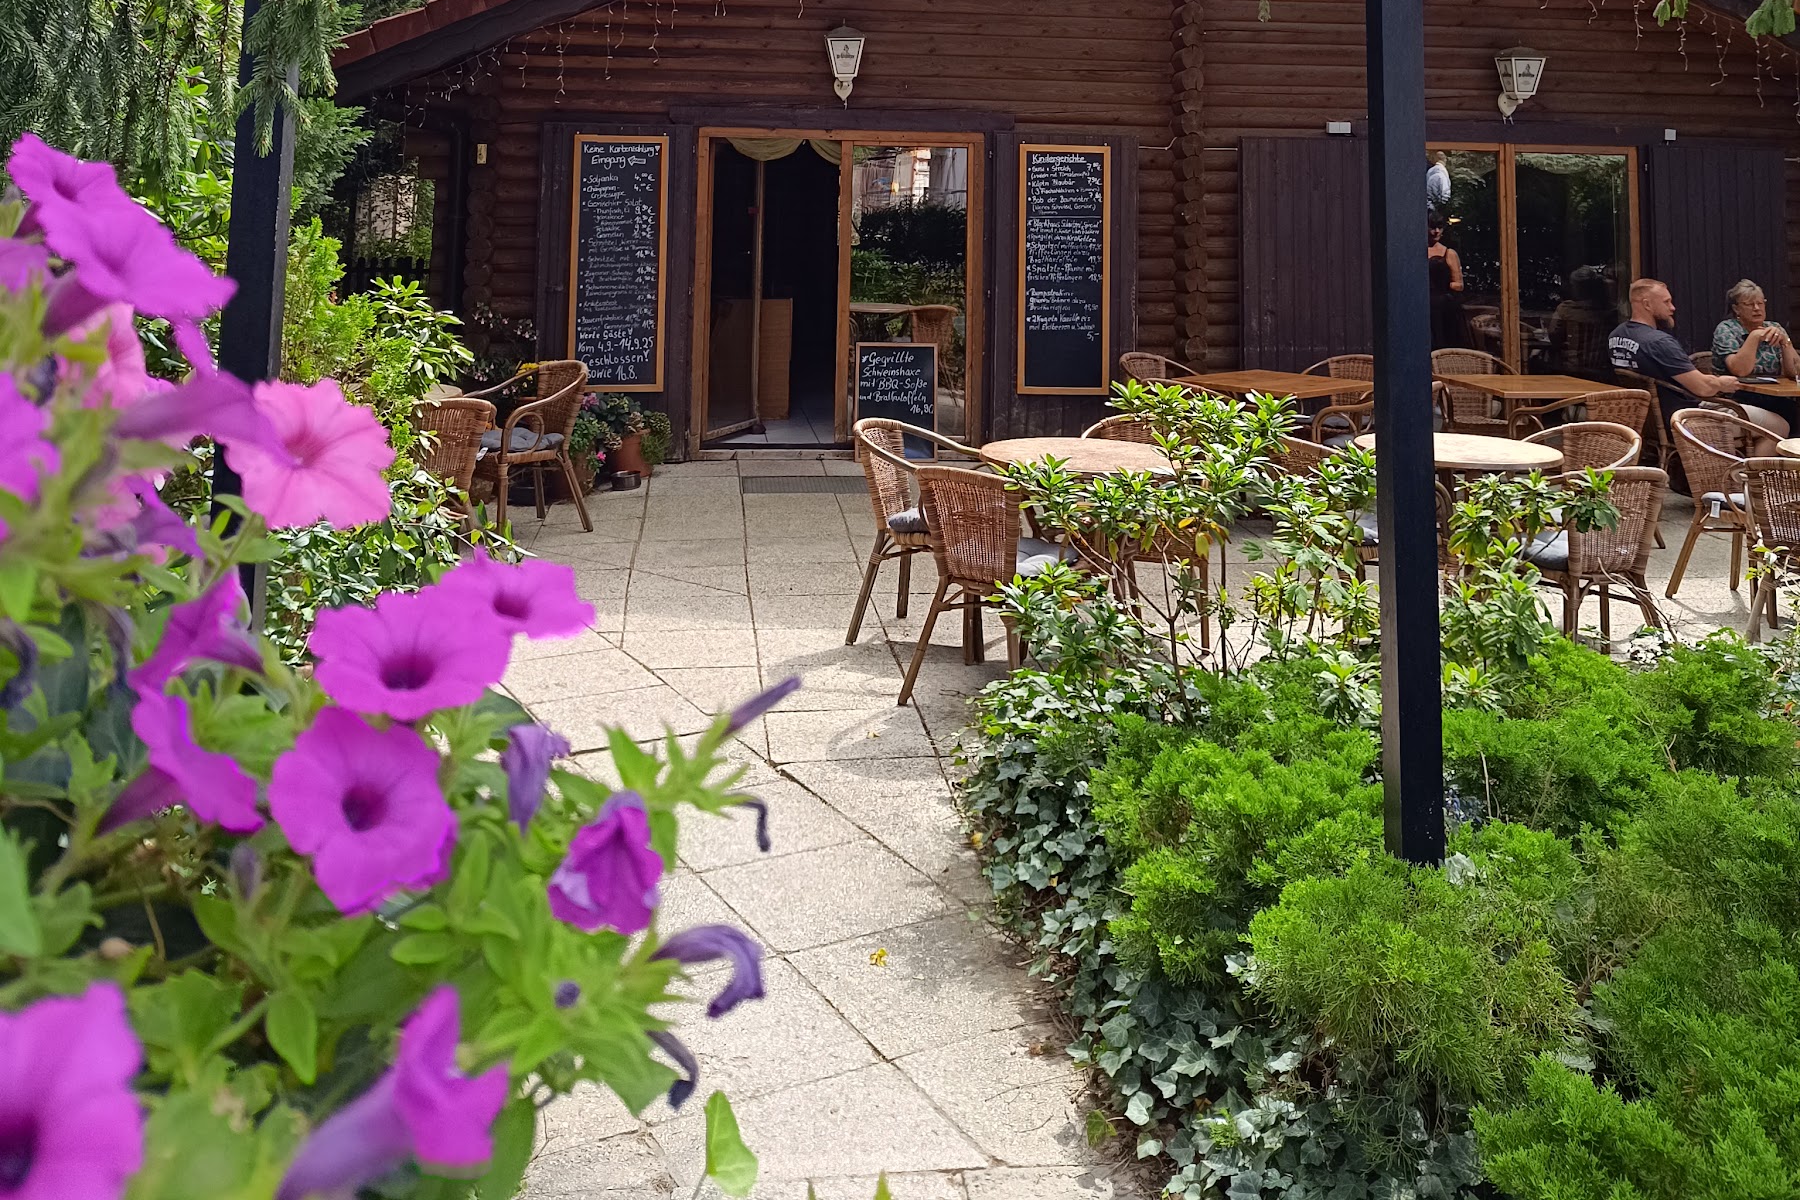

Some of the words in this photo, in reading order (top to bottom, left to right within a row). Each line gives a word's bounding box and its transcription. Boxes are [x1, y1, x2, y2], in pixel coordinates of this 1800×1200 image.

[584, 145, 605, 153] Keine
[592, 155, 626, 170] Eingang
[1032, 154, 1086, 166] Kindergerichte
[587, 173, 618, 187] Soljanka
[625, 198, 642, 206] Salat
[1031, 196, 1044, 204] Bob
[1060, 195, 1089, 203] Baumeister
[1032, 241, 1060, 250] Schnitzel
[1037, 314, 1058, 324] Kugeln
[580, 331, 600, 339] Werte
[603, 328, 633, 340] Gäste!
[578, 341, 594, 353] Vom
[581, 350, 650, 366] Geschlossen!
[868, 351, 914, 367] Gegrillte
[588, 366, 612, 378] sowie
[615, 365, 637, 381] 16.8.
[862, 366, 920, 378] Schweinshaxe
[860, 379, 875, 387] mit
[876, 377, 928, 392] BBQ-Soße
[859, 392, 872, 400] und
[873, 390, 926, 405] Bratkartoffeln
